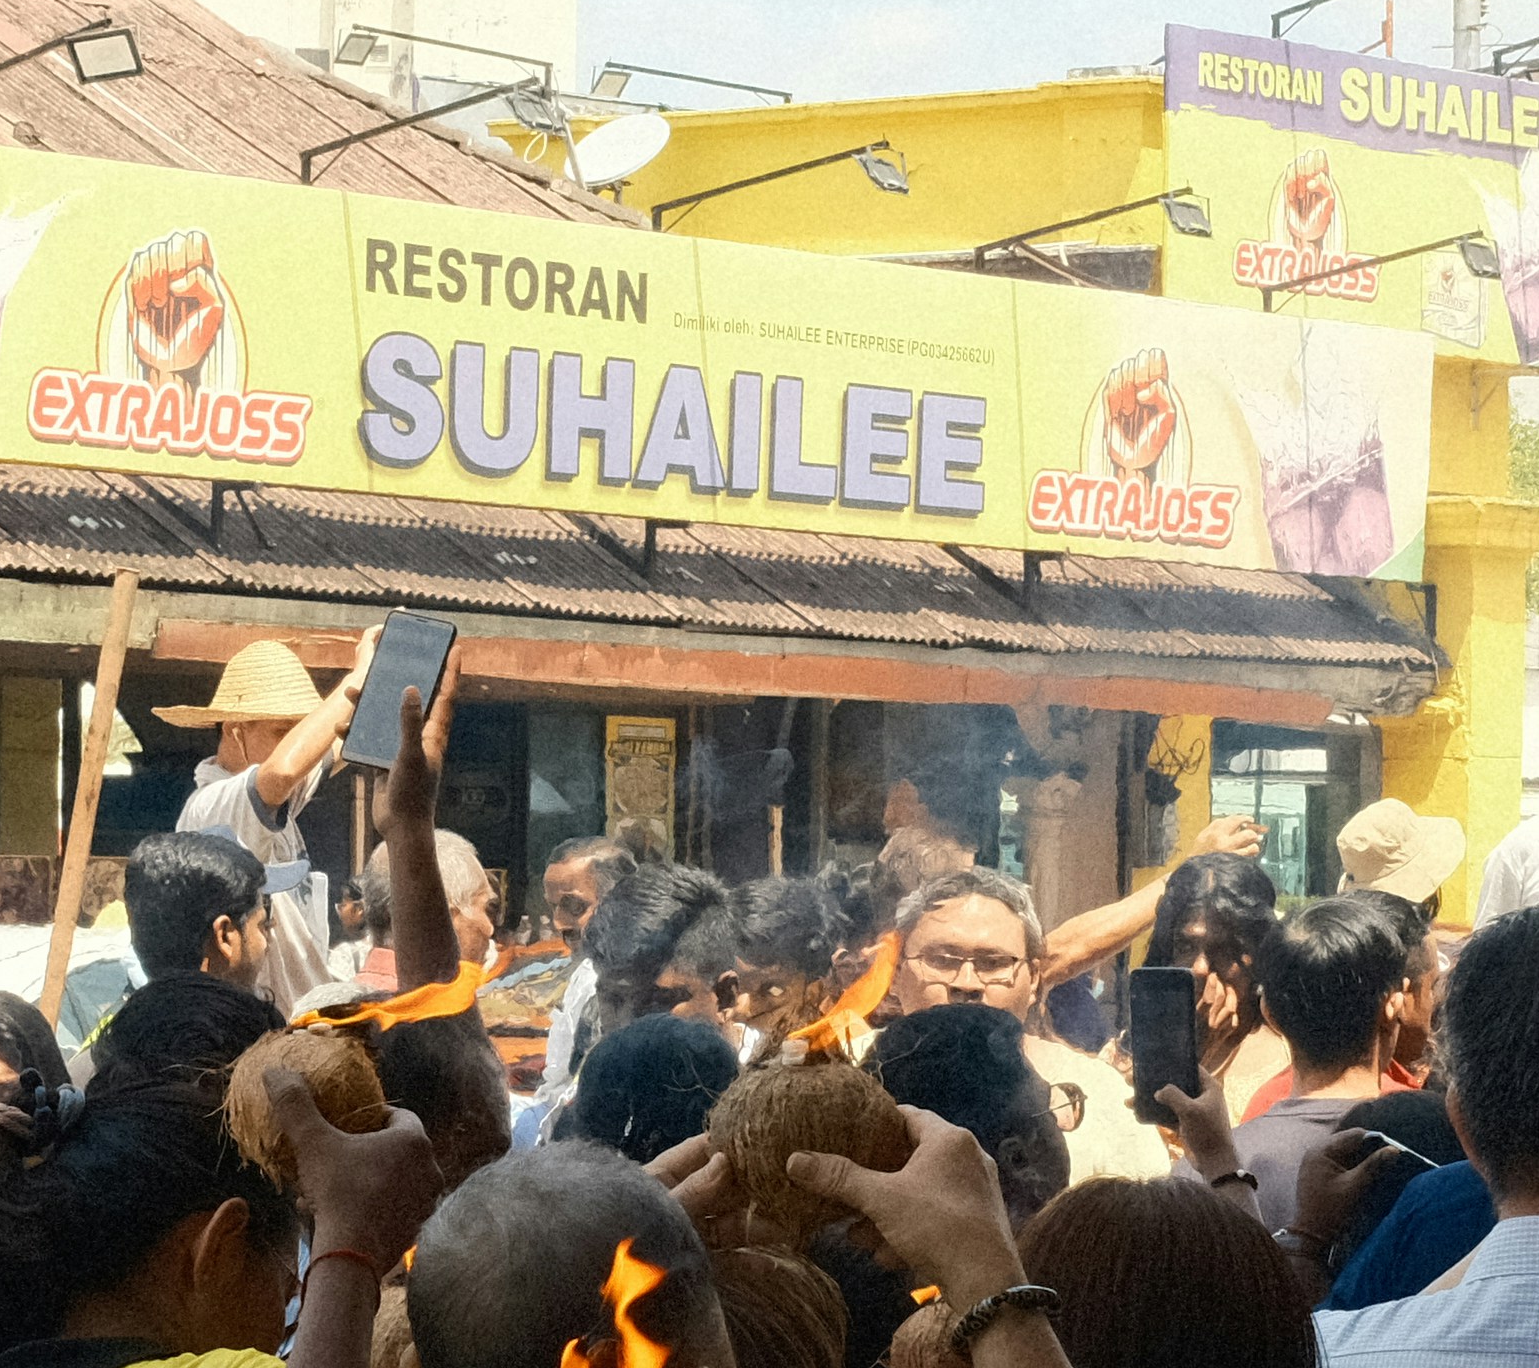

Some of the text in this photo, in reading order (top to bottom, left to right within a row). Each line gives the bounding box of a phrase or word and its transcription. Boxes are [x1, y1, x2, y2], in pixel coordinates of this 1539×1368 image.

[1198, 51, 1323, 106] RESTORAN
[365, 238, 649, 324] RESTORAN
[1235, 241, 1380, 300] EXTRAJOSS
[673, 312, 720, 333] Dimiliki
[758, 322, 822, 344] SUHAILEE
[825, 329, 905, 355] ENTERPRISE
[30, 374, 308, 458] EXTRAJOSS
[361, 331, 987, 519] SUHAILEE
[1030, 472, 1239, 544] EXTRAJOSS
